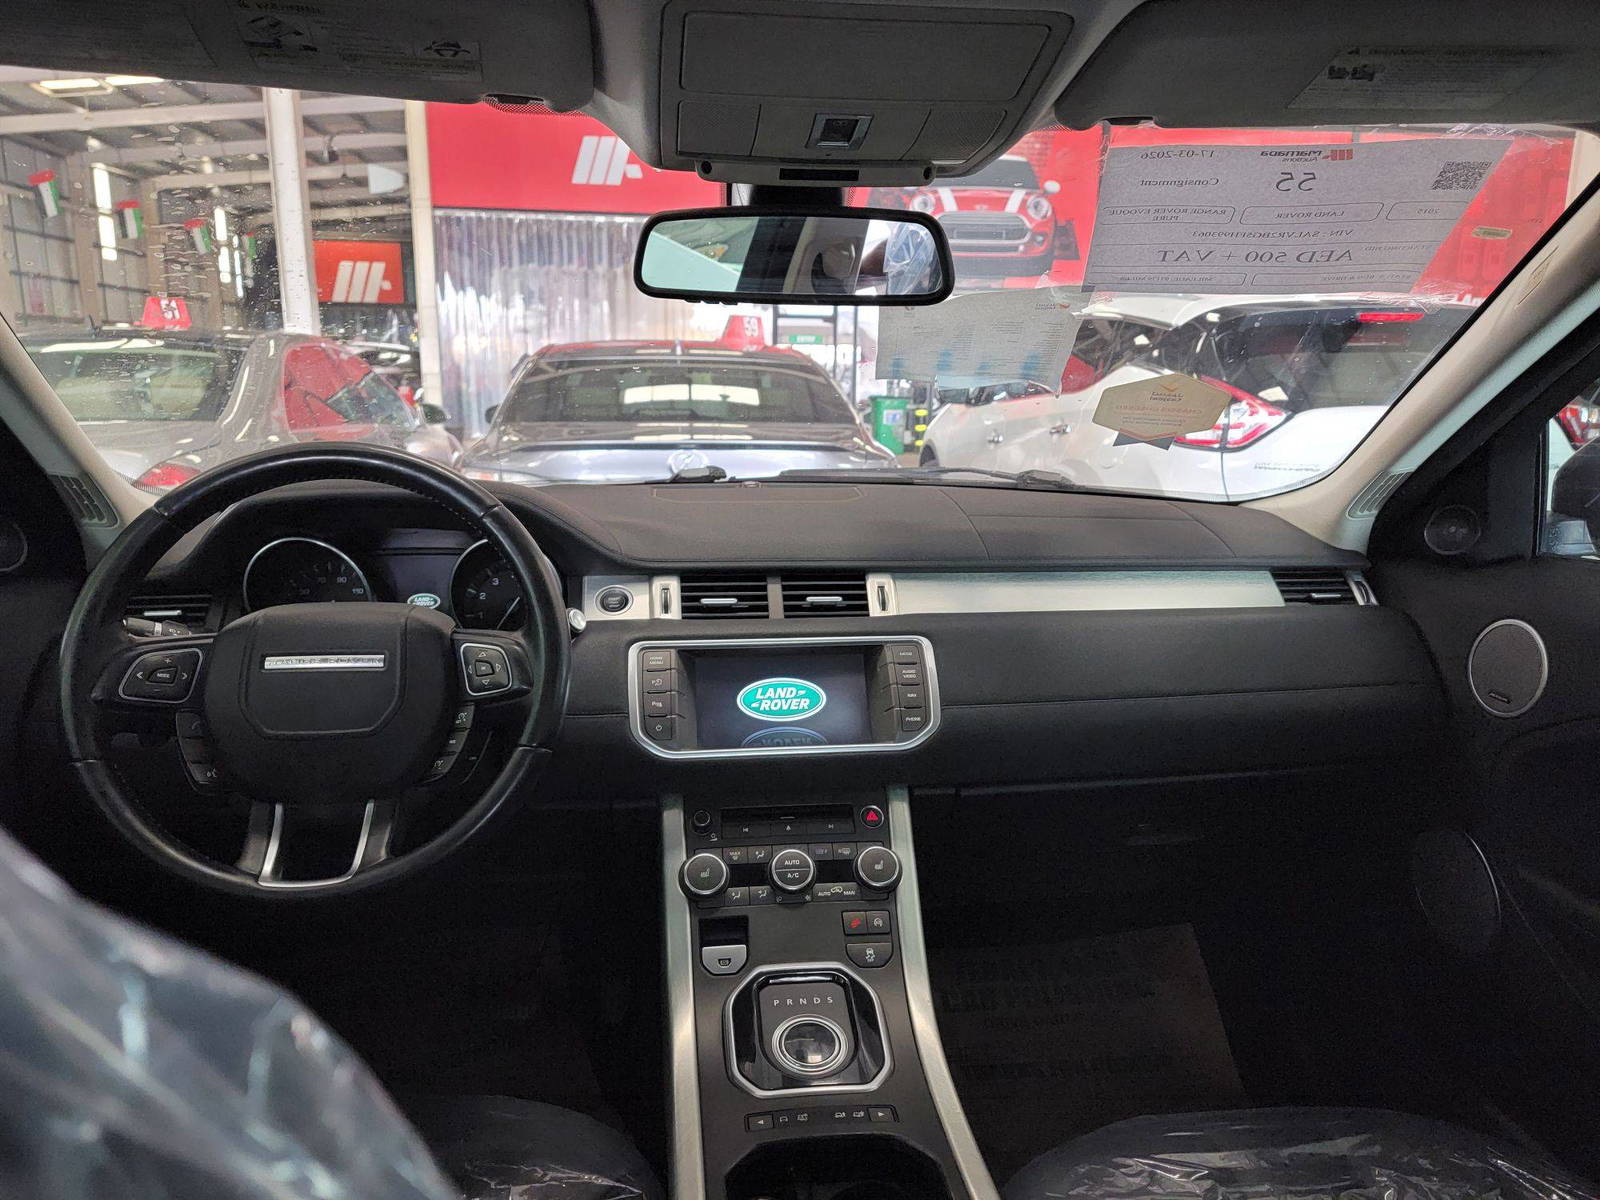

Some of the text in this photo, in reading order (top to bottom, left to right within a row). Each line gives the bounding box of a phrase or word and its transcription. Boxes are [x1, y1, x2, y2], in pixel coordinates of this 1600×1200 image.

[491, 577, 500, 586] 3
[479, 592, 486, 600] 2
[755, 687, 797, 699] LAND
[759, 697, 810, 711] ROVER
